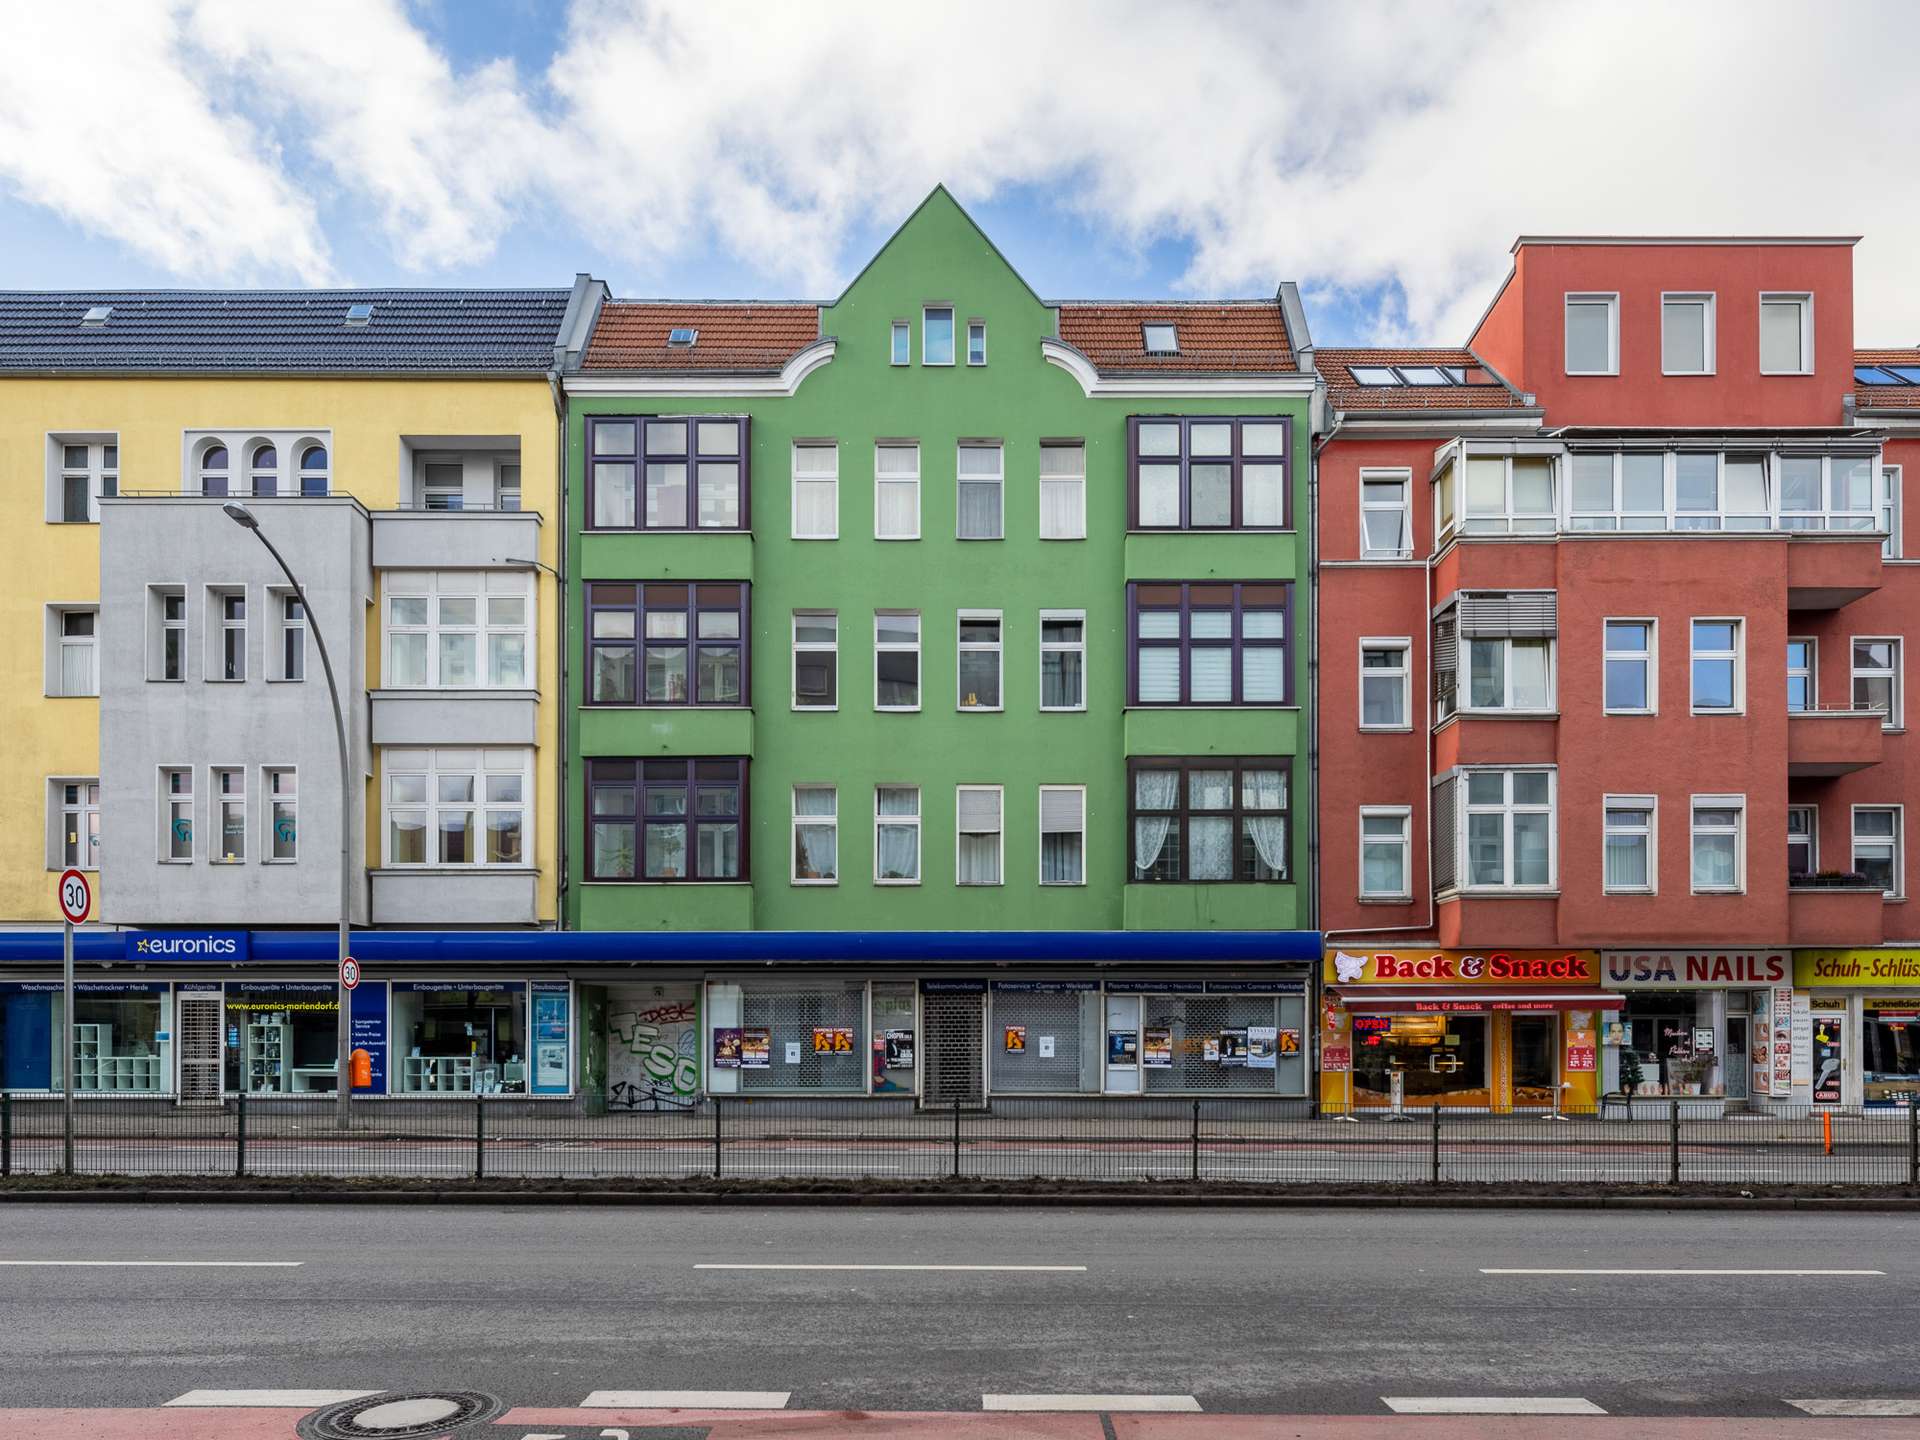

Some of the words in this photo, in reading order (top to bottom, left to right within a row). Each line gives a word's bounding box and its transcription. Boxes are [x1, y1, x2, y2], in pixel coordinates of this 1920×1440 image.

[65, 883, 84, 909] 30
[150, 935, 236, 953] euronics
[344, 966, 355, 980] 30
[1375, 955, 1456, 978] Back
[1461, 957, 1485, 978] &
[1490, 954, 1590, 978] Snack
[1608, 956, 1677, 981] USA
[1686, 955, 1785, 981] NAILS
[1814, 957, 1920, 977] Schuh-Schlüs
[226, 1001, 341, 1011] www.euronics-mariendorf.d
[1416, 1003, 1439, 1011] Back
[1453, 1003, 1483, 1011] Snack
[1812, 1000, 1840, 1009] Schuh
[1356, 1019, 1389, 1029] OPEN
